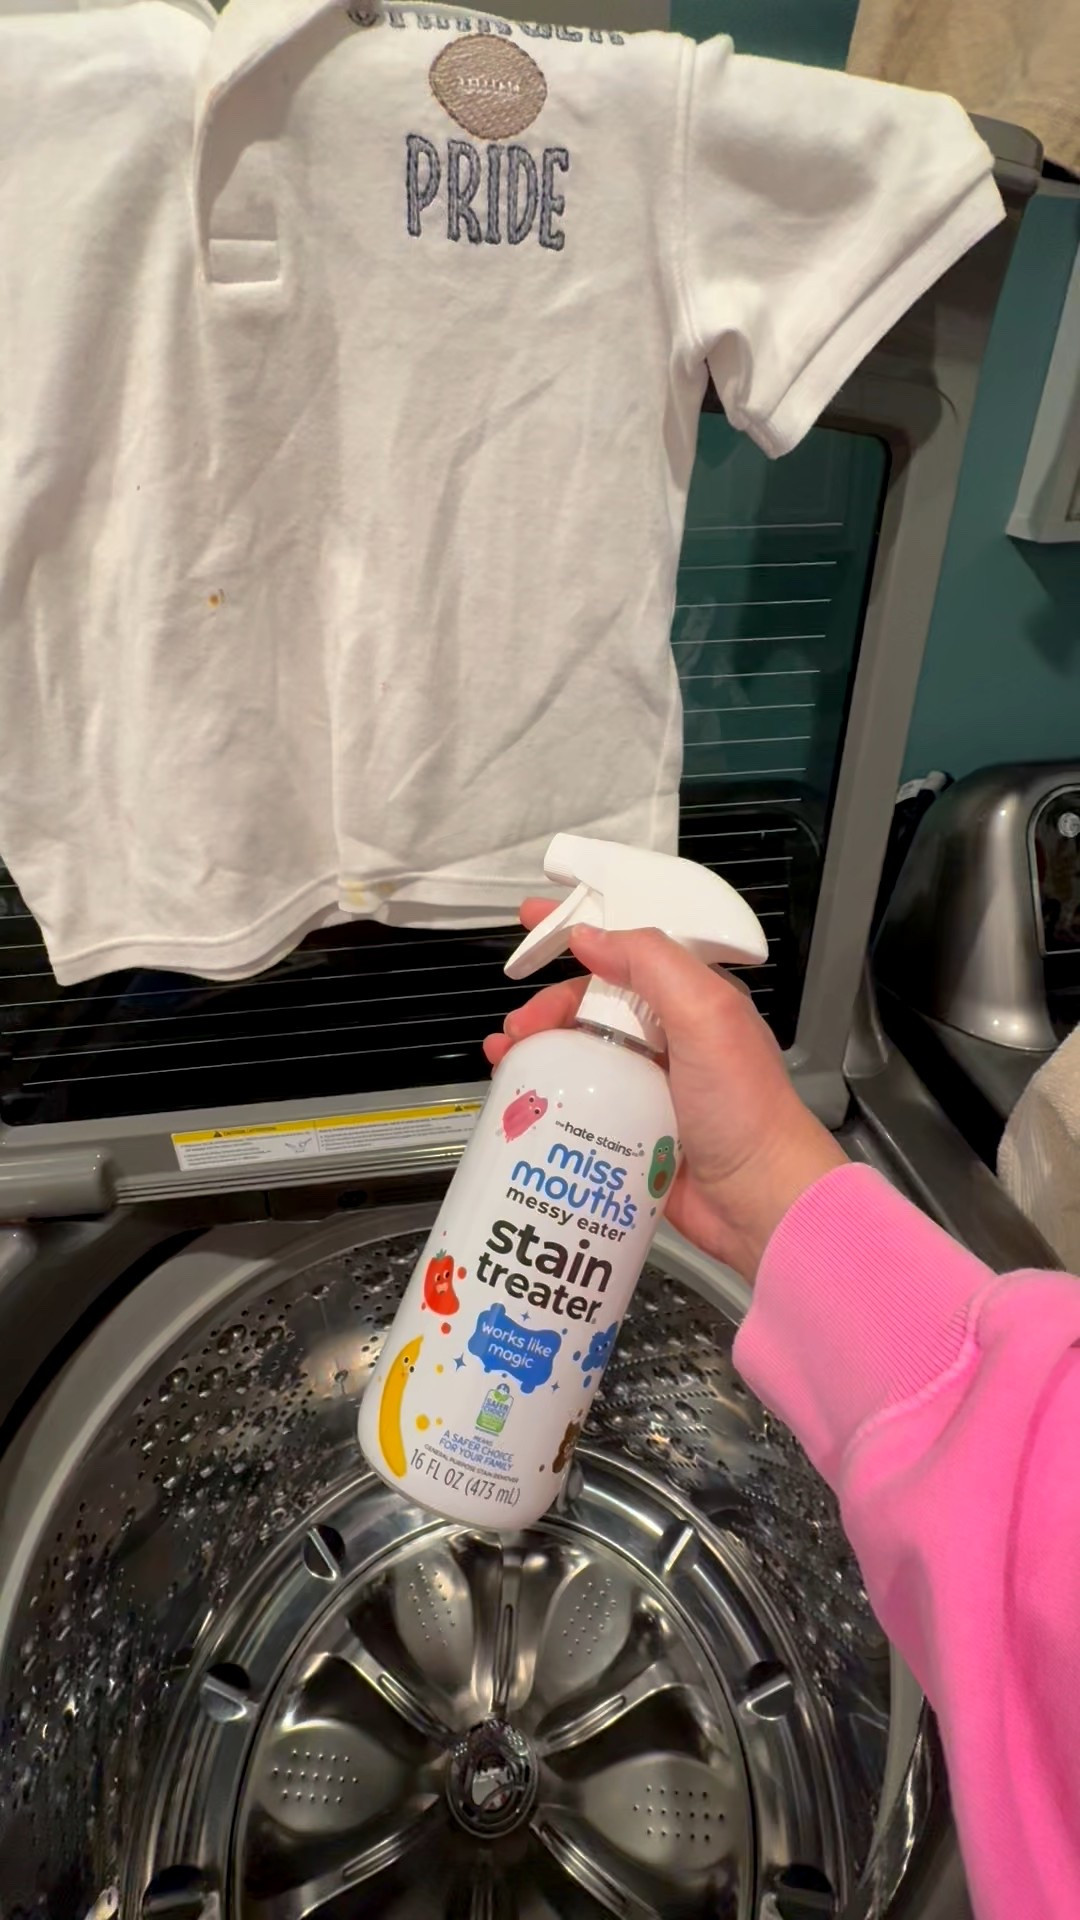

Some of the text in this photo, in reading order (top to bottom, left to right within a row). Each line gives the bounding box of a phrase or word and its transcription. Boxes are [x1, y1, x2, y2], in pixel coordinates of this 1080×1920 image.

[406, 134, 569, 251] PRIDE
[564, 1121, 595, 1142] hate
[595, 1136, 633, 1157] stains
[547, 1143, 627, 1190] miss
[505, 1186, 626, 1242] messy eater
[511, 1160, 637, 1227] mouth's
[485, 1219, 613, 1293] stain
[476, 1252, 602, 1323] treater
[481, 1321, 552, 1358] works like
[488, 1341, 534, 1369] magic
[439, 1438, 513, 1472] FOR YOUR FAMILY
[443, 1429, 514, 1463] A SAFER CHOICE
[410, 1448, 521, 1507] 16 FL OZ (473 mL)
